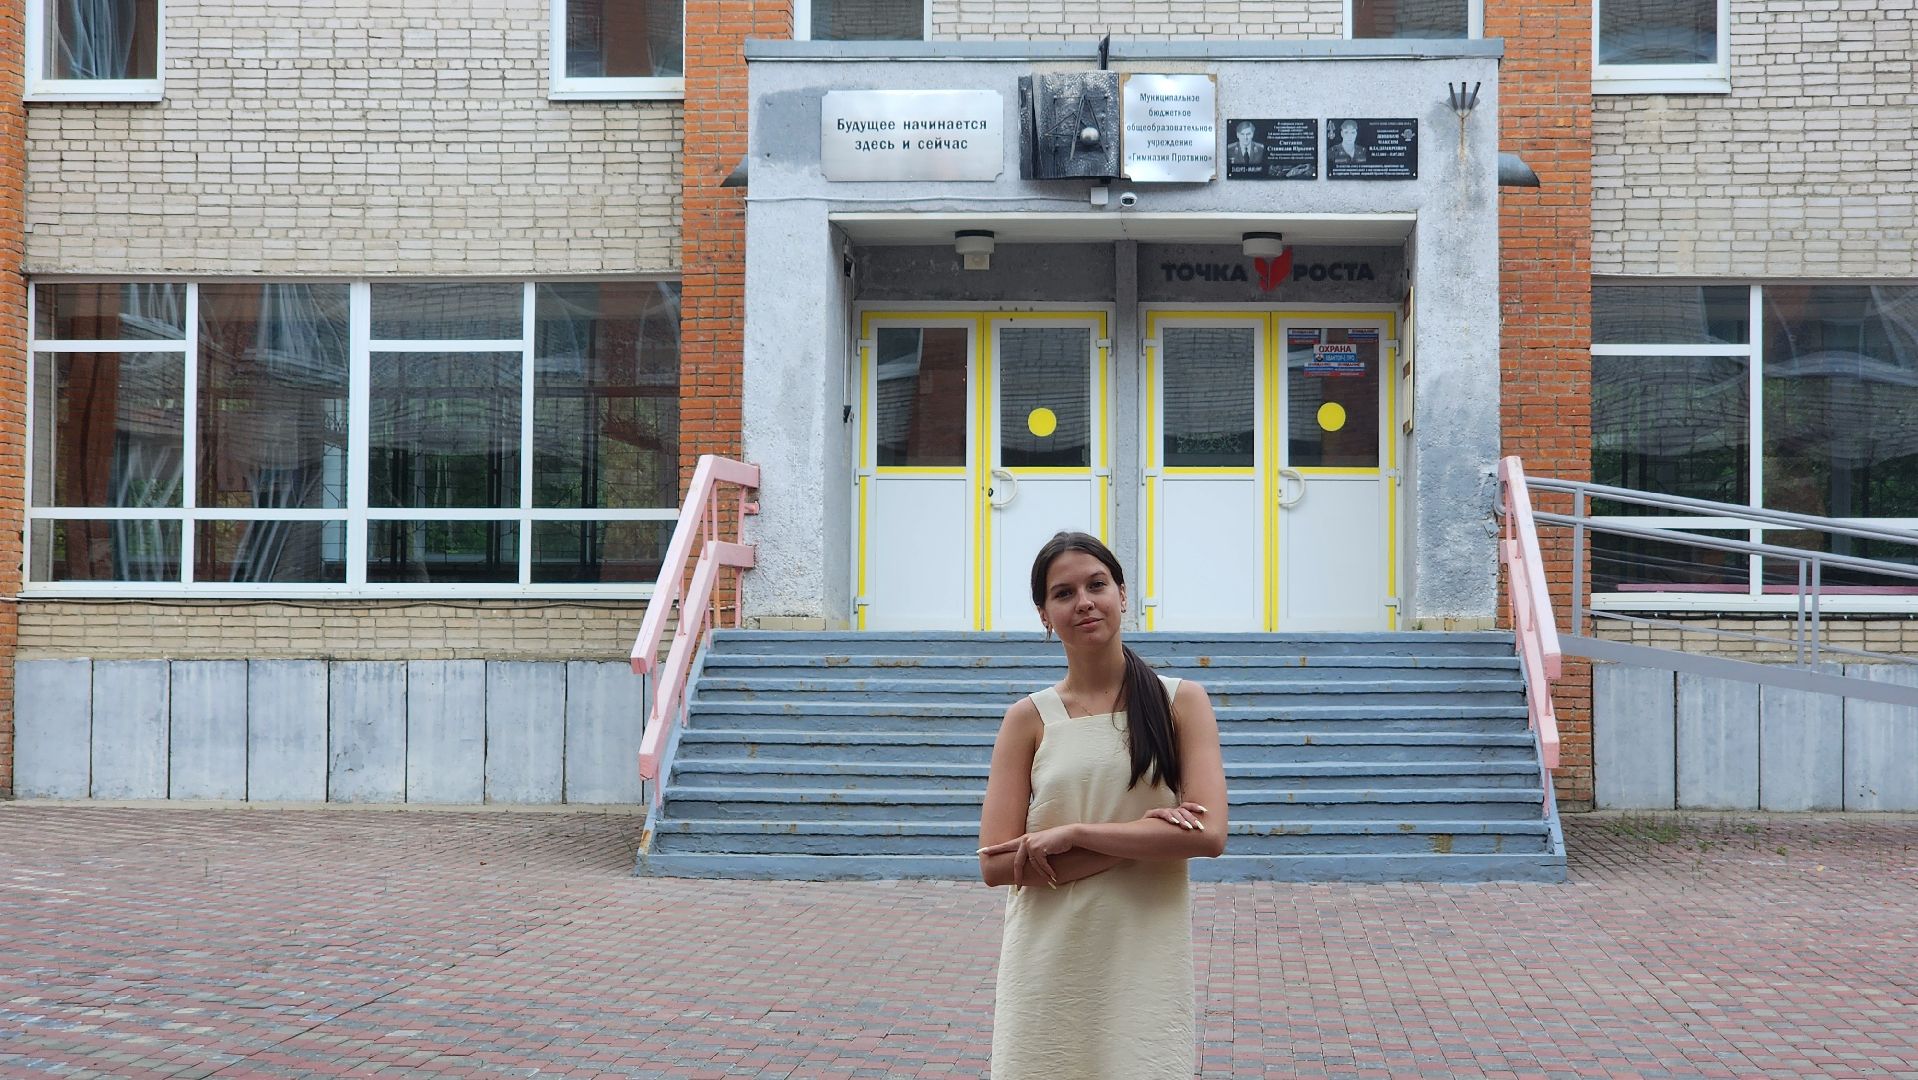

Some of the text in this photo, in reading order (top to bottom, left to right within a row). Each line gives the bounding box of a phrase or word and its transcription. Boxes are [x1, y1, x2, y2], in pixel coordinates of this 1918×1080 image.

[1140, 93, 1200, 102] Муниципальное
[1148, 108, 1192, 118] бюджетное
[837, 118, 987, 133] Будущее начинается
[1126, 124, 1212, 132] общеобразовательное
[855, 137, 968, 151] здесь и сейчас
[1147, 140, 1193, 148] учреждение
[1160, 262, 1375, 282] ТОЧКА РОСТА
